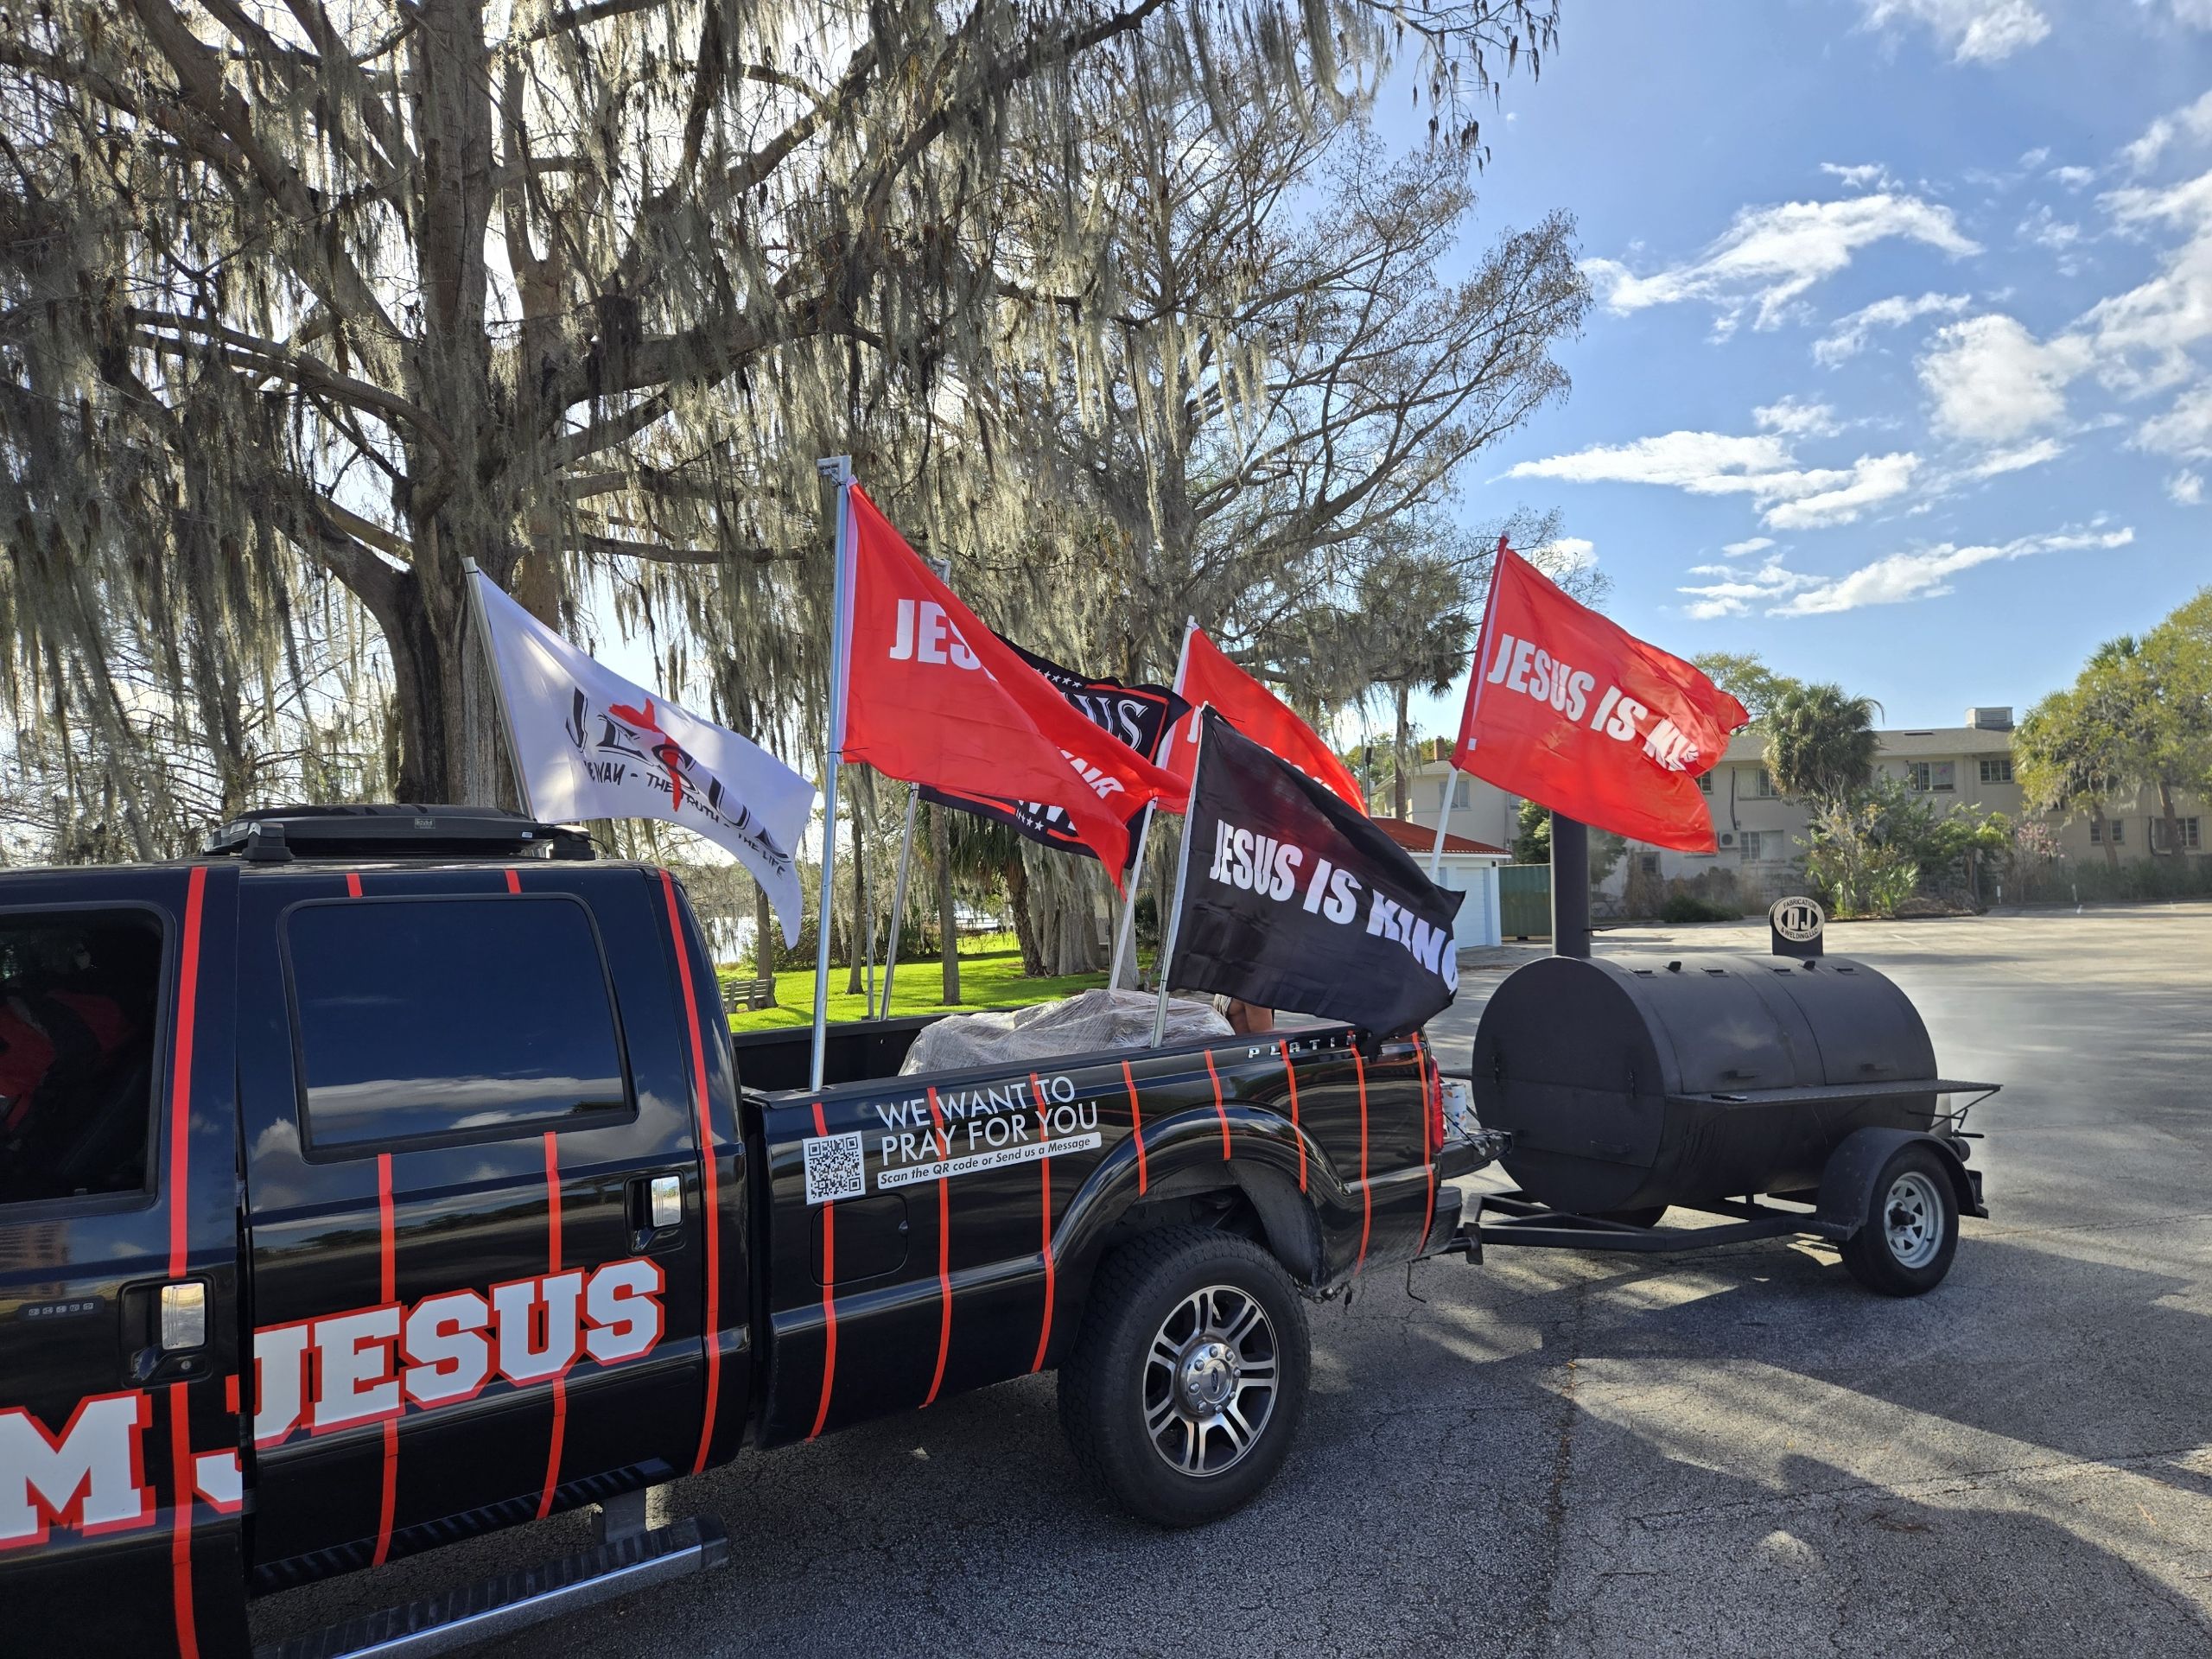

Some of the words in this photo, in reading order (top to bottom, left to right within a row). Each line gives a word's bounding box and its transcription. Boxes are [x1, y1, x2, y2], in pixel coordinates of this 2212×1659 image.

[889, 598, 999, 683] JES
[1487, 633, 1595, 722] JESUS
[1591, 685, 1648, 741] IS
[646, 772, 674, 792] THE
[1210, 818, 1303, 902] JESUS
[1303, 858, 1363, 925] IS
[1783, 899, 1817, 910] FABRICATION
[1787, 907, 1811, 931] DJ
[875, 1097, 930, 1132] WE
[936, 1082, 1027, 1122] WANT
[1034, 1076, 1076, 1105] TO
[881, 1126, 956, 1166] PRAY
[969, 1114, 1029, 1151] FOR
[1035, 1101, 1098, 1137] YOU
[880, 1170, 908, 1185] Scan
[911, 1166, 931, 1179] the
[932, 1160, 950, 1176] QR
[952, 1157, 979, 1172] code
[981, 1155, 994, 1166] or
[995, 1147, 1022, 1164] Send
[1024, 1147, 1036, 1159] us
[1038, 1146, 1046, 1156] a
[1047, 1136, 1091, 1154] Message
[191, 1256, 665, 1514] JESUS
